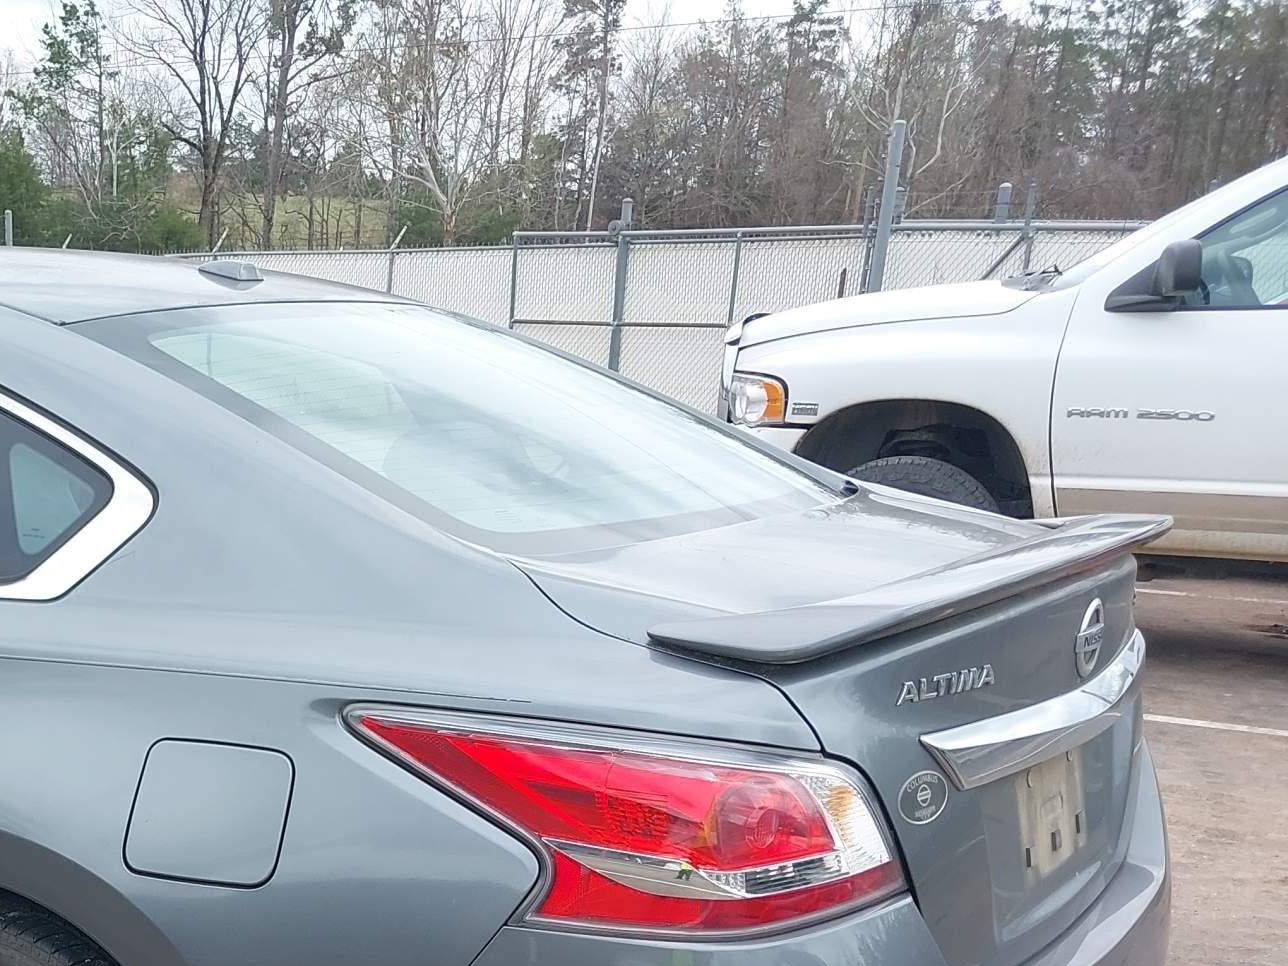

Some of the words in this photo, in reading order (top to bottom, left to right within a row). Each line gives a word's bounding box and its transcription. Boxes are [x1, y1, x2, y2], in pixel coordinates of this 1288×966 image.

[1067, 407, 1129, 419] RAM
[1136, 408, 1215, 421] 2500
[895, 664, 995, 706] ALTIMA
